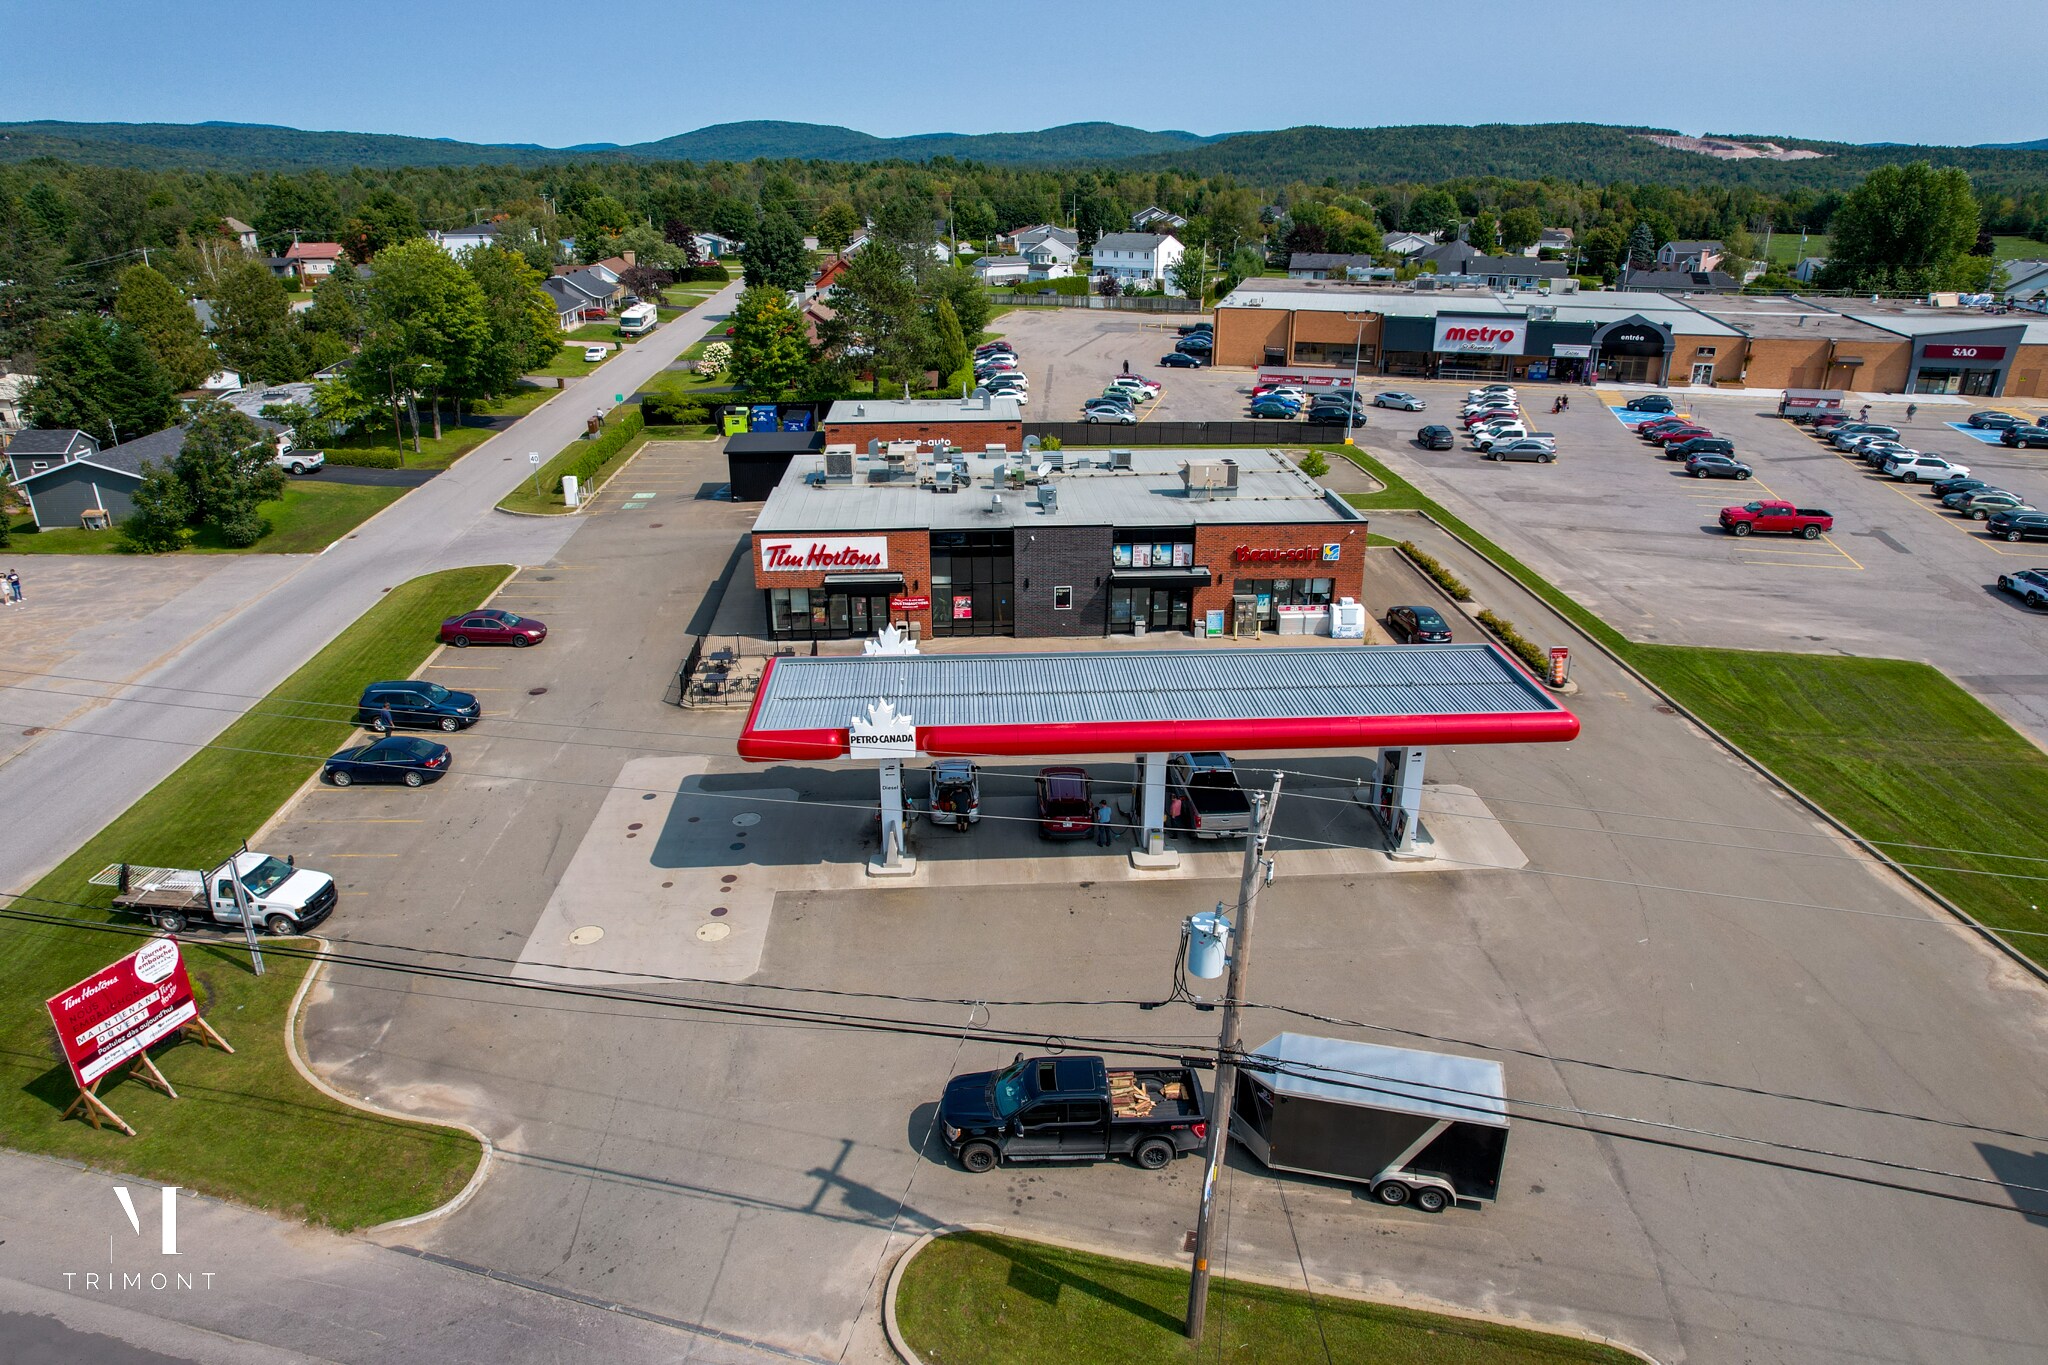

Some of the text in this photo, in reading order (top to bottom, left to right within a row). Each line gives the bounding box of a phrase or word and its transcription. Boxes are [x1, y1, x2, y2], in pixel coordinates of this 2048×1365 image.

[1446, 325, 1515, 343] metro
[1952, 348, 1978, 357] SAQ
[767, 543, 881, 567] Tim Hortons
[1235, 544, 1320, 562] Beau-soir
[850, 734, 914, 744] PETRO-CANADA
[138, 946, 175, 970] embauche!
[61, 976, 119, 1011] Tim Hortons
[158, 981, 173, 996] Tim
[69, 1002, 99, 1024] NOUS
[72, 986, 147, 1033] EMBAUCHONS
[77, 992, 159, 1045] MAINTENANT
[98, 1010, 147, 1043] OUVERT
[97, 1036, 127, 1055] Postulez
